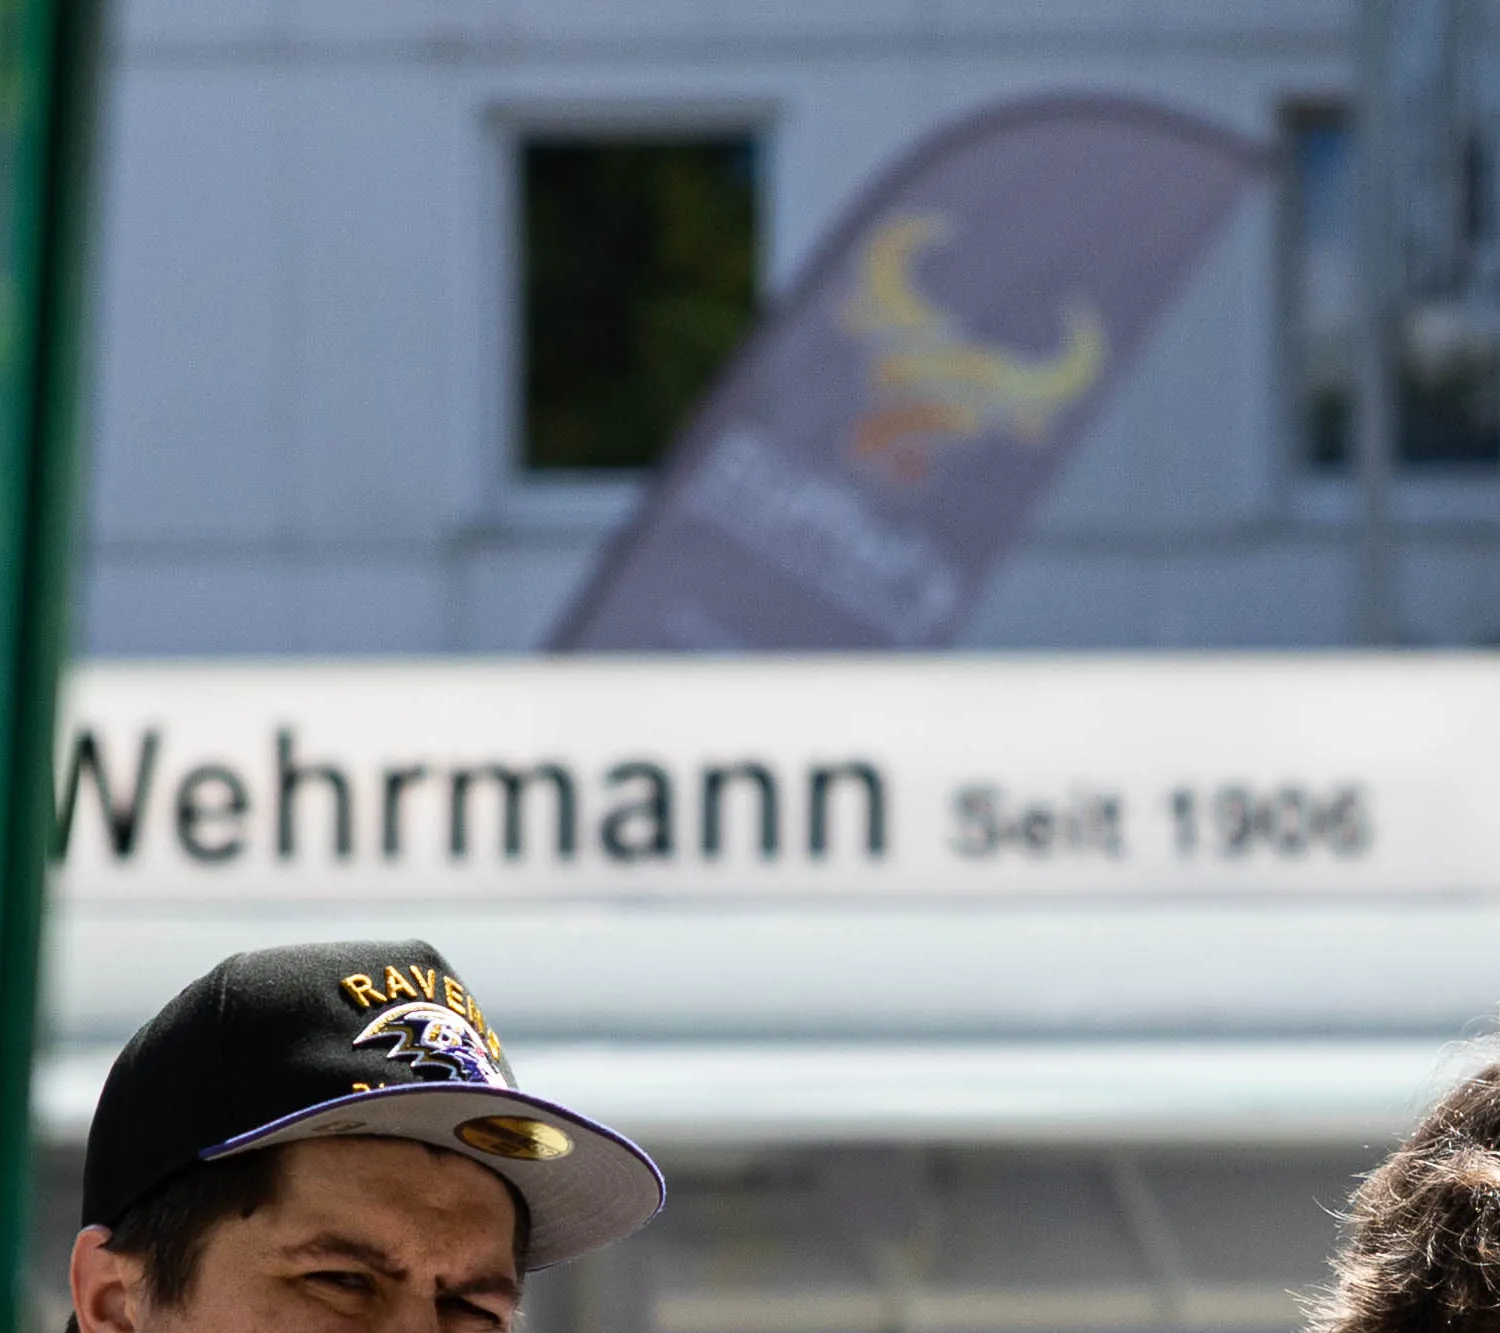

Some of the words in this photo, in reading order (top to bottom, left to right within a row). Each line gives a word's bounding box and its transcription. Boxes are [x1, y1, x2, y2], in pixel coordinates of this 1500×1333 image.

[49, 728, 886, 866] Wehrmann
[950, 784, 1126, 858] Seit
[1164, 780, 1378, 862] 1906
